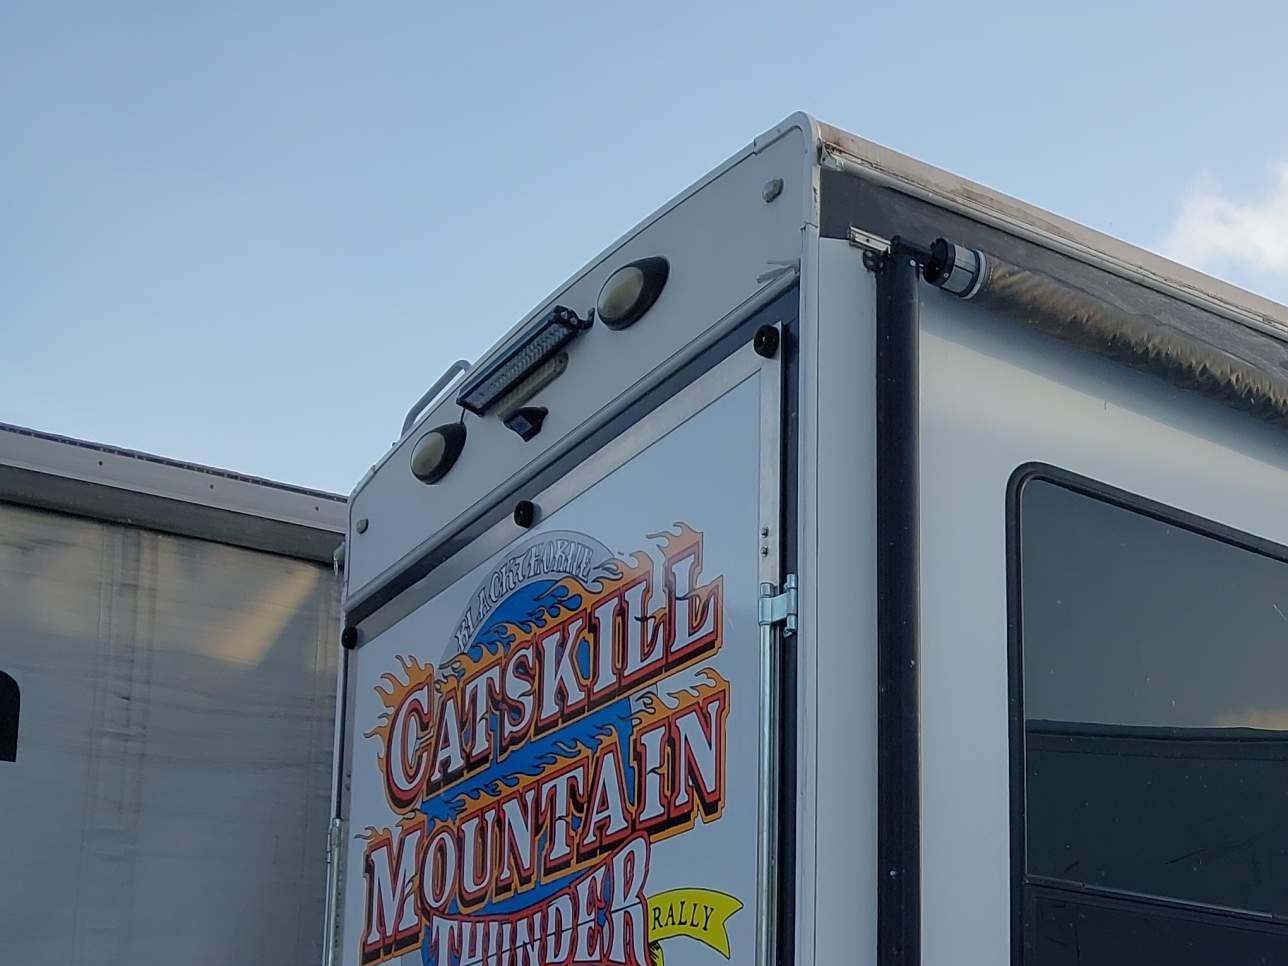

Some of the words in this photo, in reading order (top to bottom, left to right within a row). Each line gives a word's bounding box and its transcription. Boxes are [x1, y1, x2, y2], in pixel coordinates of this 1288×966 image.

[386, 543, 724, 808] CATSKILL
[362, 686, 728, 956] MOUNTAIN
[651, 901, 715, 932] RALLY
